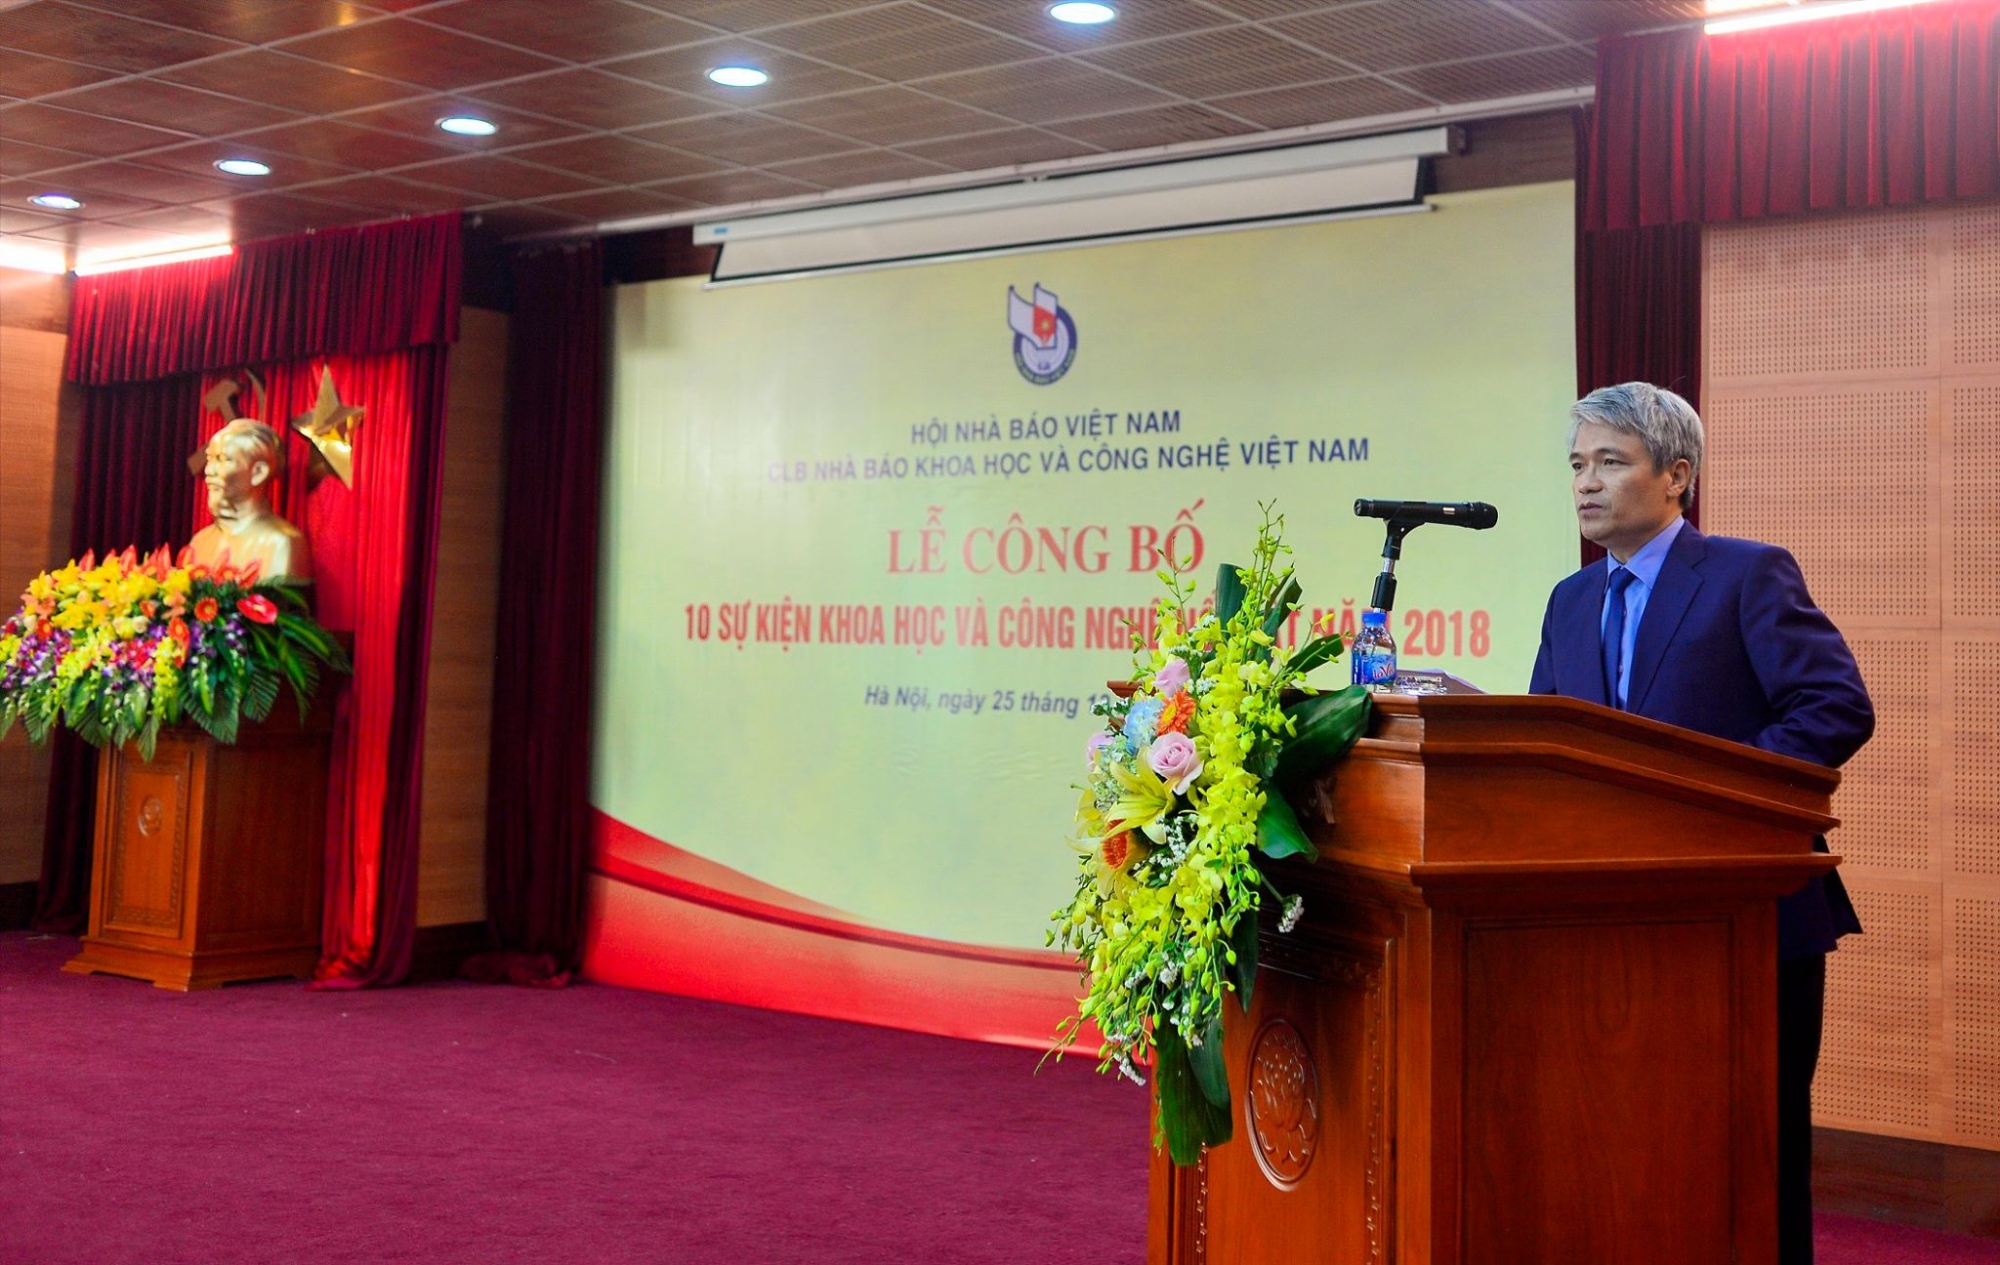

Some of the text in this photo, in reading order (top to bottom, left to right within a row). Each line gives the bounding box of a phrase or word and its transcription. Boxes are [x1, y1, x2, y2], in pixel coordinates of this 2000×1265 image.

[911, 408, 1180, 448] HỘI NHÀ BÁO VIỆT NAM
[768, 435, 1369, 484] CLB NHÀ BÁO KHOA HỌC VÀ CÔNG NGHỆ VIỆT NAM
[887, 498, 1205, 575] LỄ CÔNG BỐ
[685, 603, 711, 641] 10
[718, 600, 752, 651] SỰ
[756, 595, 811, 652] KIỆN
[820, 605, 885, 645] KHOA
[893, 605, 946, 655] HỌC
[955, 596, 989, 647] VÀ
[1000, 597, 1075, 648] CÔNG
[1313, 597, 1391, 648] NĂ
[1404, 609, 1490, 657] 2018
[864, 686, 889, 706] Hà
[895, 687, 931, 712] Nội,
[937, 689, 986, 714] ngày
[992, 690, 1014, 711] 25
[1020, 691, 1079, 719] tháng
